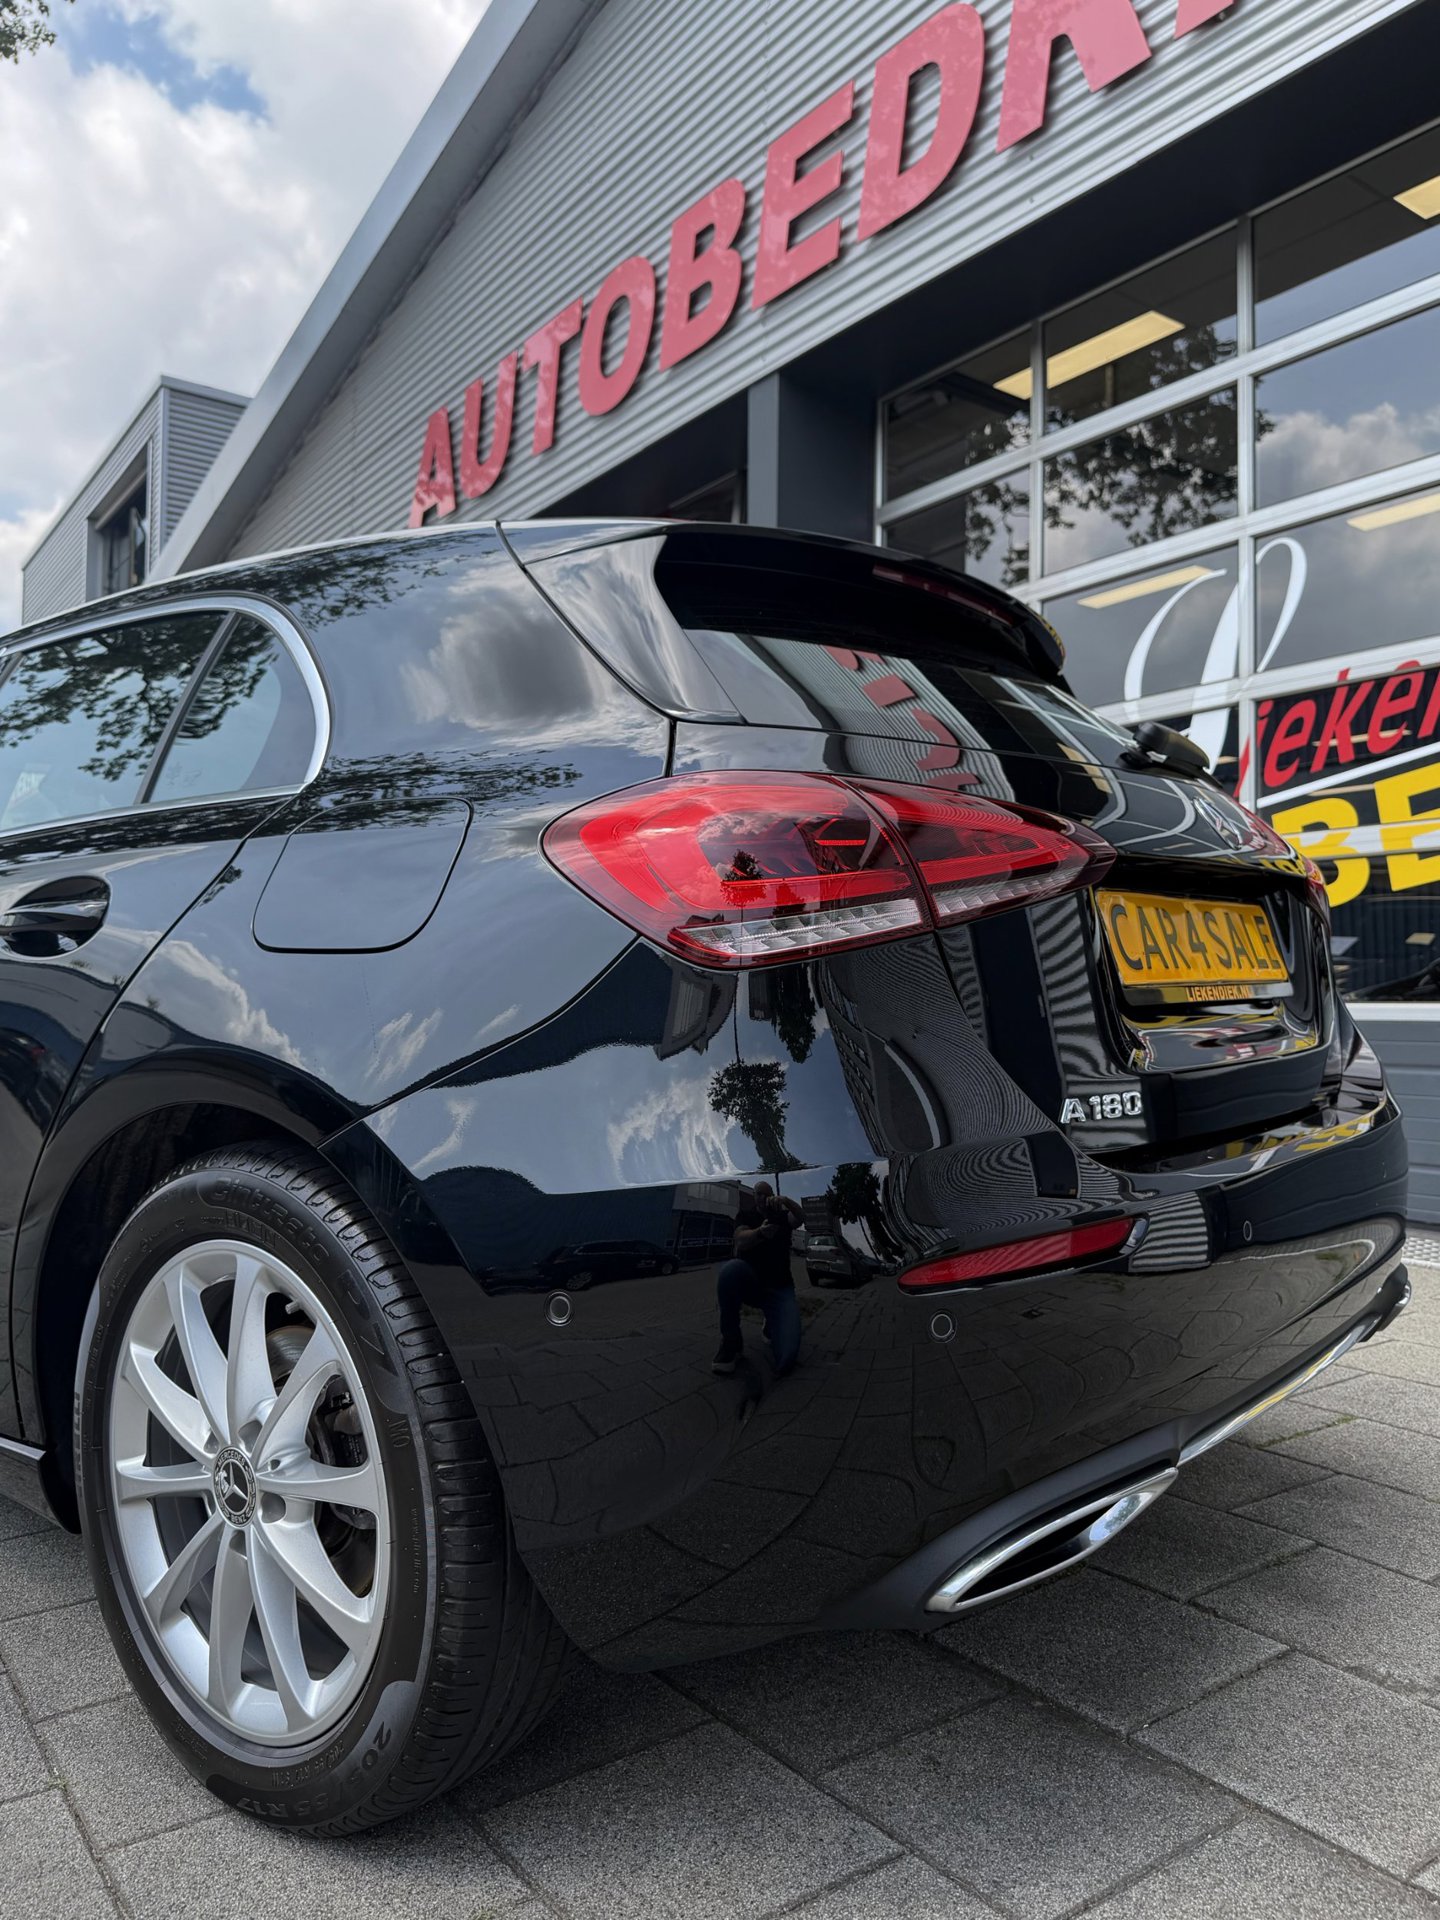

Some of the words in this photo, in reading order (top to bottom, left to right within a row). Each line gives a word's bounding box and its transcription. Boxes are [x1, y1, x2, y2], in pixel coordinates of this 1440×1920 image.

[1111, 904, 1282, 970] CAR4SALE
[1186, 984, 1253, 1002] LIEKENDIEK.NL
[1061, 1098, 1086, 1124] A
[1088, 1091, 1143, 1120] 180
[217, 1450, 246, 1467] MERCEDES
[230, 1513, 247, 1525] BENZ
